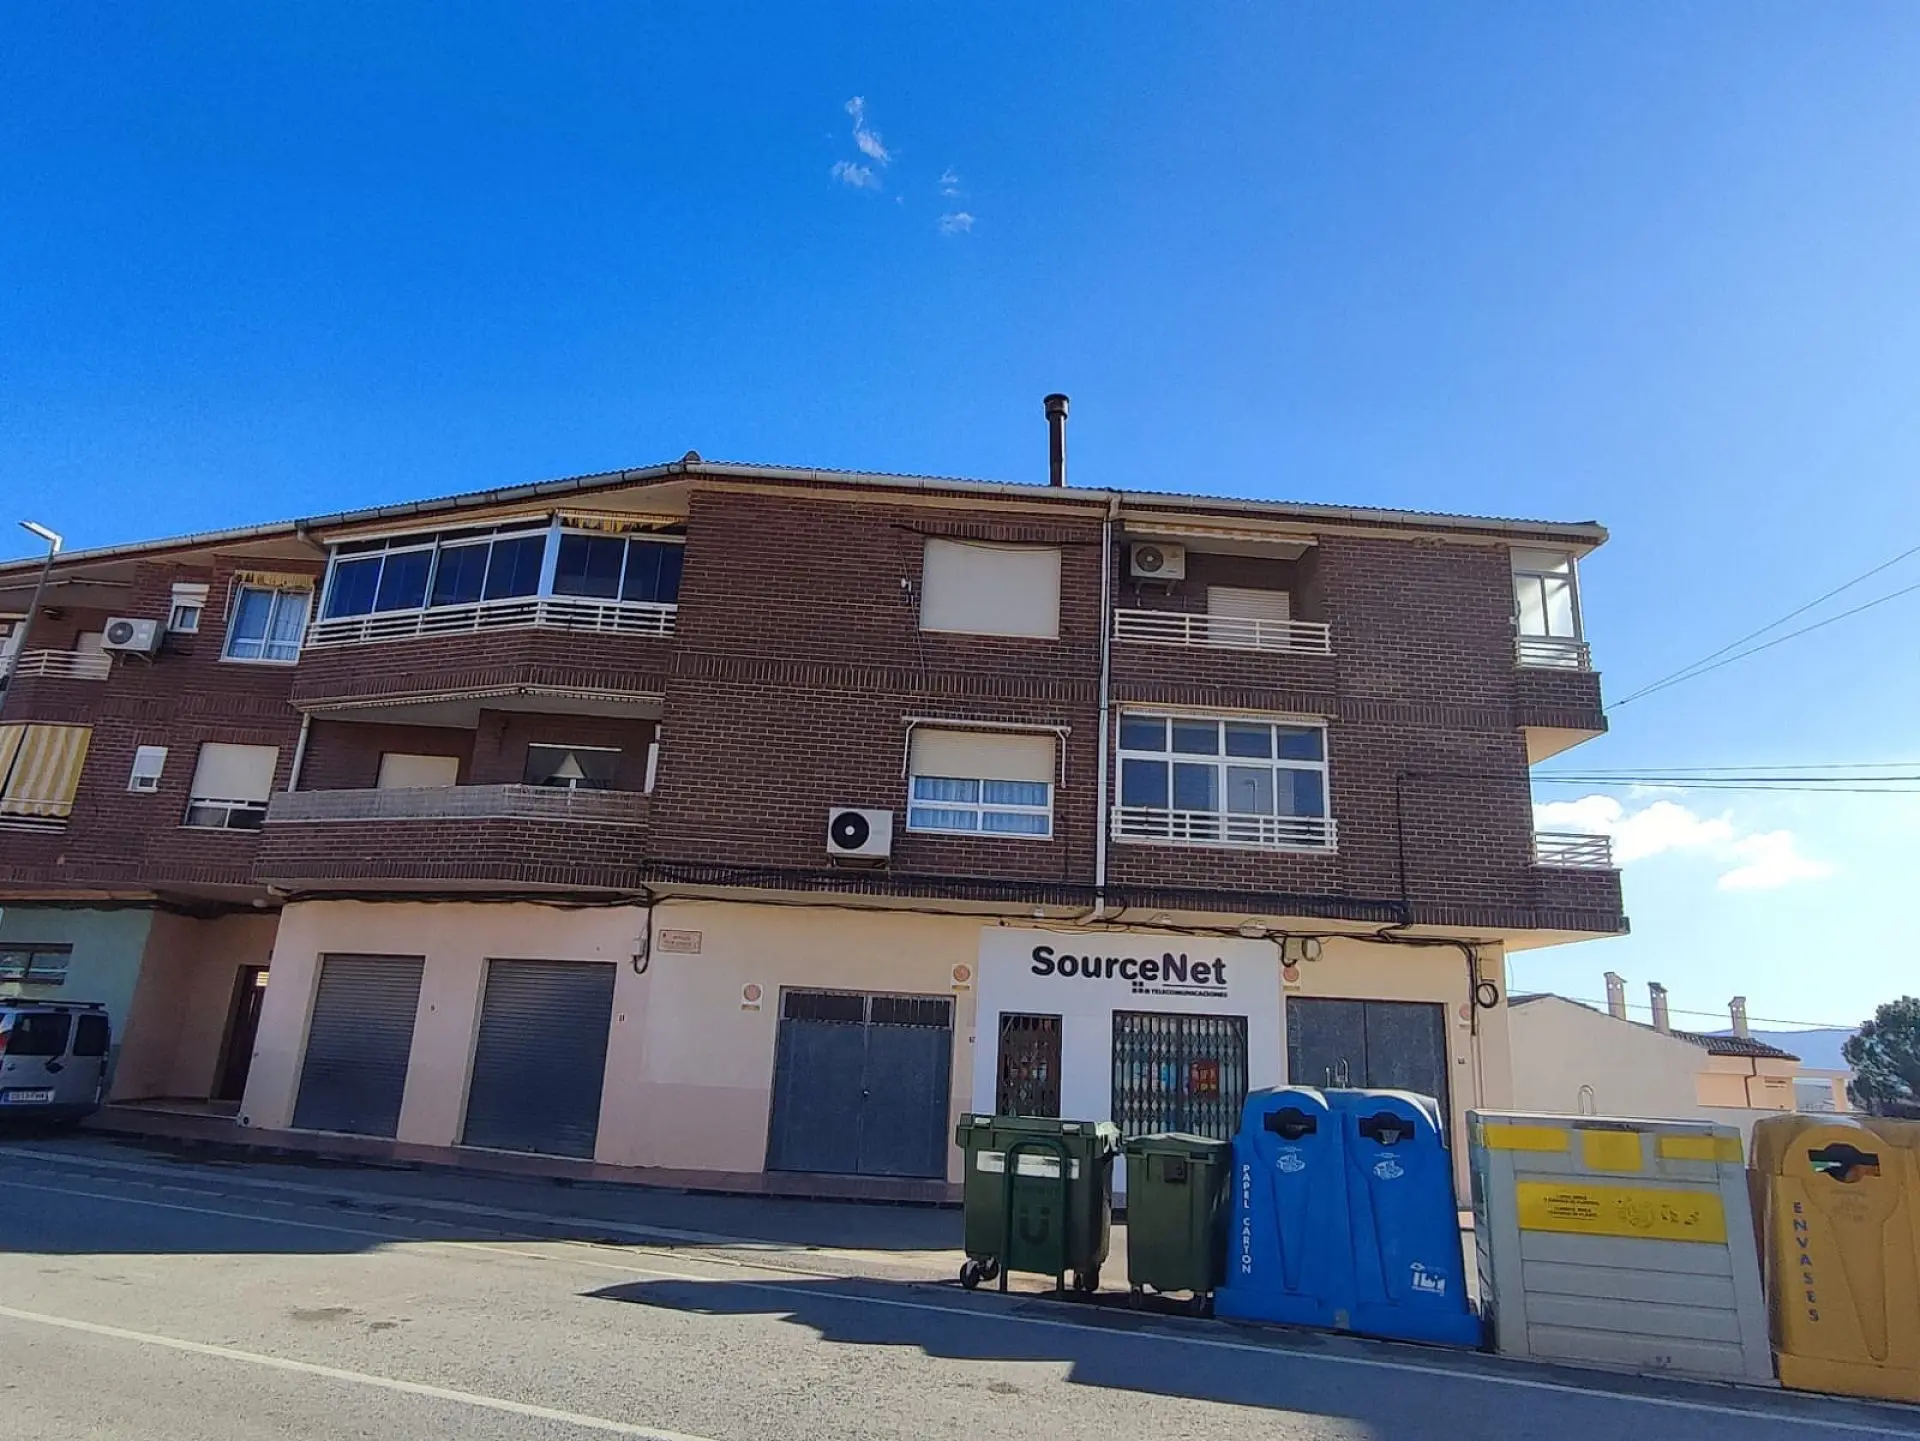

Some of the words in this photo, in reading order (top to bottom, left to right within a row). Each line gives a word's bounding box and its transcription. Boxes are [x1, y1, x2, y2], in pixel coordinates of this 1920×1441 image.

[1031, 946, 1227, 985] SourceNet
[1242, 1164, 1251, 1209] PAPEL
[1241, 1217, 1252, 1274] CARTON
[1793, 1201, 1819, 1322] ENVASES
